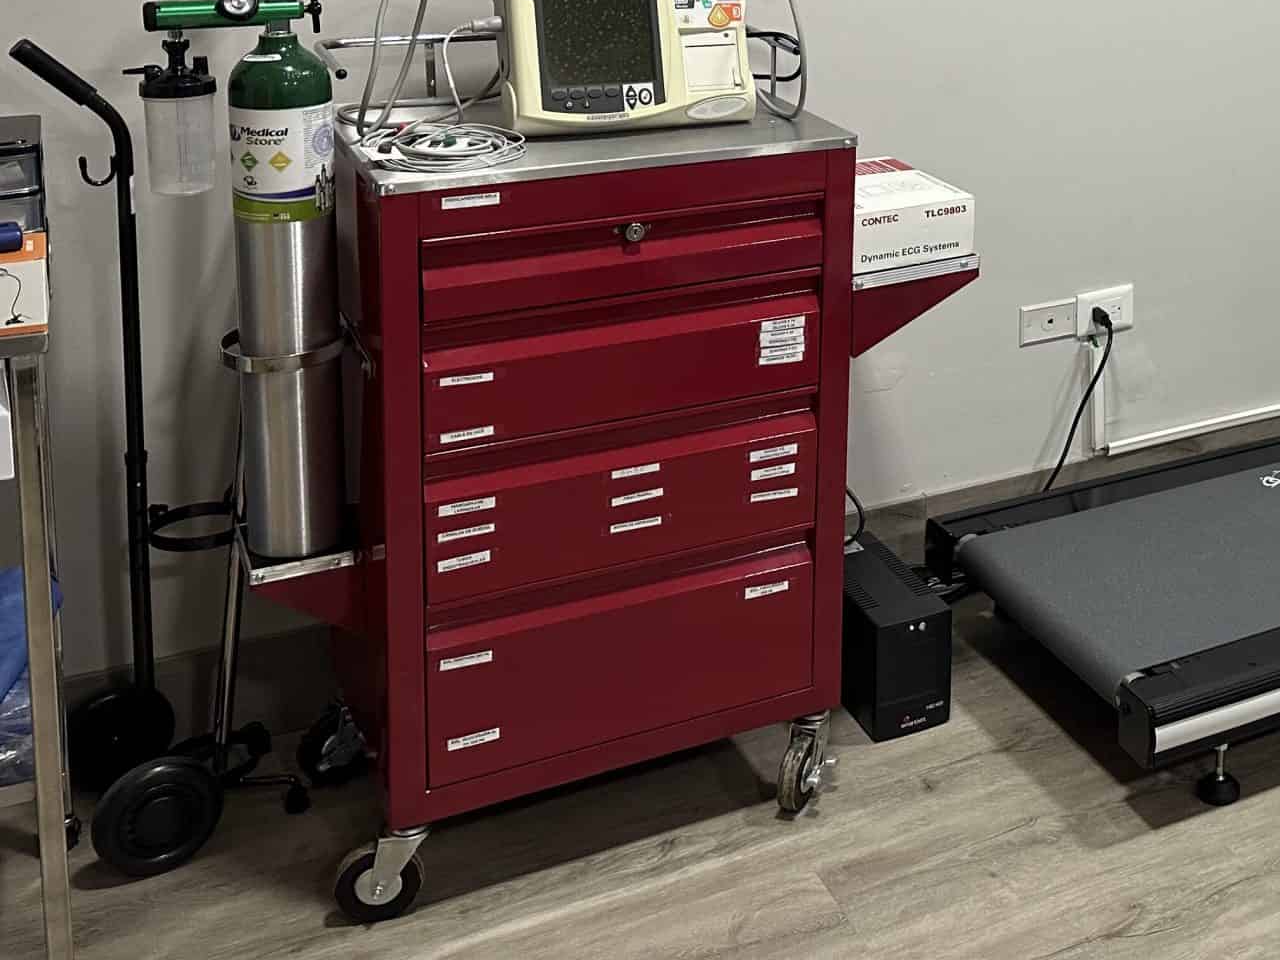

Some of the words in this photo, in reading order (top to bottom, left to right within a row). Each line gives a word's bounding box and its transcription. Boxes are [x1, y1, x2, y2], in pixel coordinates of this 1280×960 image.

[240, 127, 288, 137] Medical
[246, 137, 284, 146] Store
[861, 214, 899, 227] CONTEC
[924, 204, 967, 219] TLC9803
[861, 249, 900, 263] Dynamic
[902, 246, 921, 257] ECG
[922, 240, 960, 254] Systems
